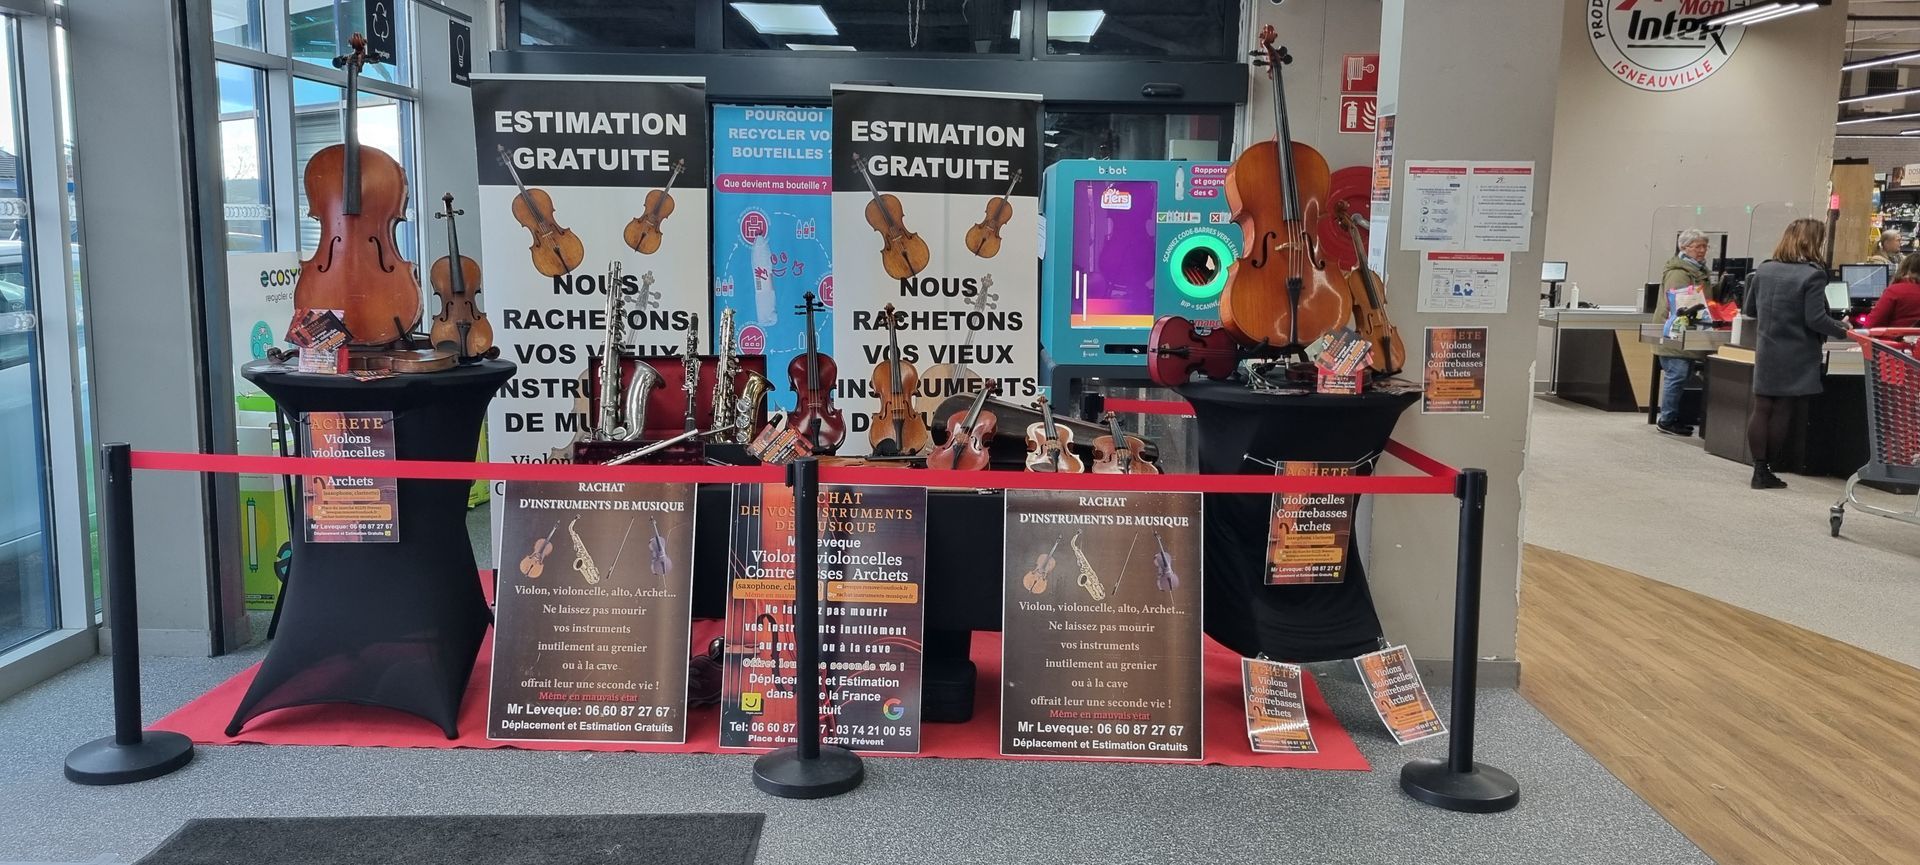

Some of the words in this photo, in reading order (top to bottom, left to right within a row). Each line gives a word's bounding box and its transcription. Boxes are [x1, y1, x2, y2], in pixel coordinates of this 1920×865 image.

[1613, 60, 1713, 88] ISNEAUVILLE
[745, 110, 823, 122] POURQUOI
[495, 111, 686, 135] ESTIMATION
[729, 128, 805, 141] RECYCLER
[810, 130, 831, 141] VO
[851, 120, 1025, 148] ESTIMATION
[513, 147, 670, 172] GRATUITE
[732, 147, 823, 160] BOUTEILLES
[868, 155, 1010, 181] GRATUITE
[724, 179, 740, 189] Que
[742, 179, 772, 189] devient
[786, 179, 820, 191] bouteille
[821, 181, 827, 190] ?
[901, 277, 978, 297] NOUS
[266, 292, 287, 303] recycler
[504, 309, 689, 330] RACHEONS
[853, 311, 1023, 331] RACHETONS
[1440, 341, 1472, 349] Violons
[515, 344, 576, 364] VOS
[929, 345, 1013, 364] VIEUX
[1431, 350, 1480, 358] violoncelles
[1428, 360, 1483, 368] Contrebasses
[312, 418, 383, 430] ACHETE
[505, 413, 543, 432] DE
[852, 413, 871, 432] D
[324, 433, 371, 443] Violons
[312, 447, 385, 458] violoncelles
[1288, 468, 1348, 476] ACHETE
[328, 476, 373, 486] Archets
[579, 483, 625, 492] RACHAT
[520, 499, 612, 510] D'INSTRUMENTS
[614, 501, 630, 510] DE
[631, 501, 684, 512] MUSIQUE
[1079, 497, 1127, 507] RACHAT
[1282, 494, 1344, 505] violoncelles
[1277, 508, 1347, 518] Contrebasses
[1020, 514, 1114, 525] D'INSTRUMENTS
[1117, 515, 1132, 525] DE
[1134, 516, 1188, 527] MUSIQUE
[1291, 522, 1331, 532] Archets
[818, 551, 902, 566] violoncelles
[853, 567, 908, 582] Archets
[515, 586, 550, 596] Violon,
[553, 586, 609, 597] violoncelle,
[543, 605, 556, 613] Ne
[559, 605, 591, 614] laissez
[593, 607, 609, 617] pas
[611, 607, 647, 615] mourir
[827, 608, 845, 617] pas
[850, 607, 888, 617] mourir
[1019, 602, 1055, 612] Violon,
[1058, 602, 1115, 613] violoncelle,
[554, 625, 570, 633] vos
[572, 624, 631, 634] instruments
[840, 625, 907, 635] inutilement
[1049, 621, 1063, 630] Ne
[1065, 621, 1097, 630] laissez
[1100, 624, 1117, 634] pas
[1119, 623, 1155, 633] mourir
[538, 642, 594, 651] inutilement
[611, 644, 647, 654] grenier
[865, 645, 891, 654] cave
[1080, 640, 1140, 651] instruments
[830, 661, 876, 671] seconde
[1046, 659, 1103, 669] inutilement
[1120, 660, 1157, 671] grenier
[1374, 665, 1402, 678] Violons
[521, 679, 551, 688] offrait
[554, 679, 574, 689] leur
[597, 681, 636, 690] seconde
[638, 681, 652, 690] vie
[839, 677, 899, 688] Estimation
[1107, 680, 1128, 688] cave
[1258, 676, 1288, 688] Violons
[1371, 673, 1413, 689] violoncelles
[767, 690, 793, 699] dans
[843, 691, 881, 701] France
[1250, 686, 1297, 699] violoncelles
[1373, 681, 1420, 699] Contrebasses
[1031, 696, 1062, 706] offrait
[1064, 696, 1084, 706] leur
[1108, 698, 1148, 708] seconde
[1150, 699, 1165, 708] vie
[1249, 695, 1301, 709] Contrebasses
[1387, 693, 1415, 706] Archets
[508, 704, 523, 714] Mr
[527, 704, 581, 718] Leveque:
[585, 705, 599, 716] 06
[603, 705, 617, 716] 60
[621, 705, 634, 716] 87
[638, 706, 652, 717] 27
[656, 706, 670, 717] 67
[1262, 707, 1292, 718] Archets
[502, 720, 565, 732] Déplacement
[580, 722, 631, 731] Estimation
[635, 723, 673, 732] Gratuits
[730, 722, 748, 732] Tel:
[752, 722, 764, 732] 06
[767, 723, 780, 732] 60
[783, 723, 795, 733] 87
[836, 725, 849, 735] 03
[852, 725, 864, 735] 74
[868, 726, 879, 735] 21
[883, 726, 895, 735] 00
[899, 726, 912, 736] 55
[1018, 722, 1034, 733] Mr
[1038, 723, 1093, 736] Leveque:
[1097, 724, 1111, 734] 06
[1115, 724, 1129, 735] 60
[1133, 725, 1147, 735] 87
[1151, 725, 1165, 736] 27
[1169, 725, 1184, 736] 67
[748, 735, 772, 743] Place
[823, 737, 849, 745] 62270
[851, 737, 884, 745] Frévent
[1013, 738, 1078, 750] Déplacement
[1080, 740, 1089, 749] et
[1092, 740, 1145, 750] Estimation
[1148, 741, 1188, 752] Gratuits
